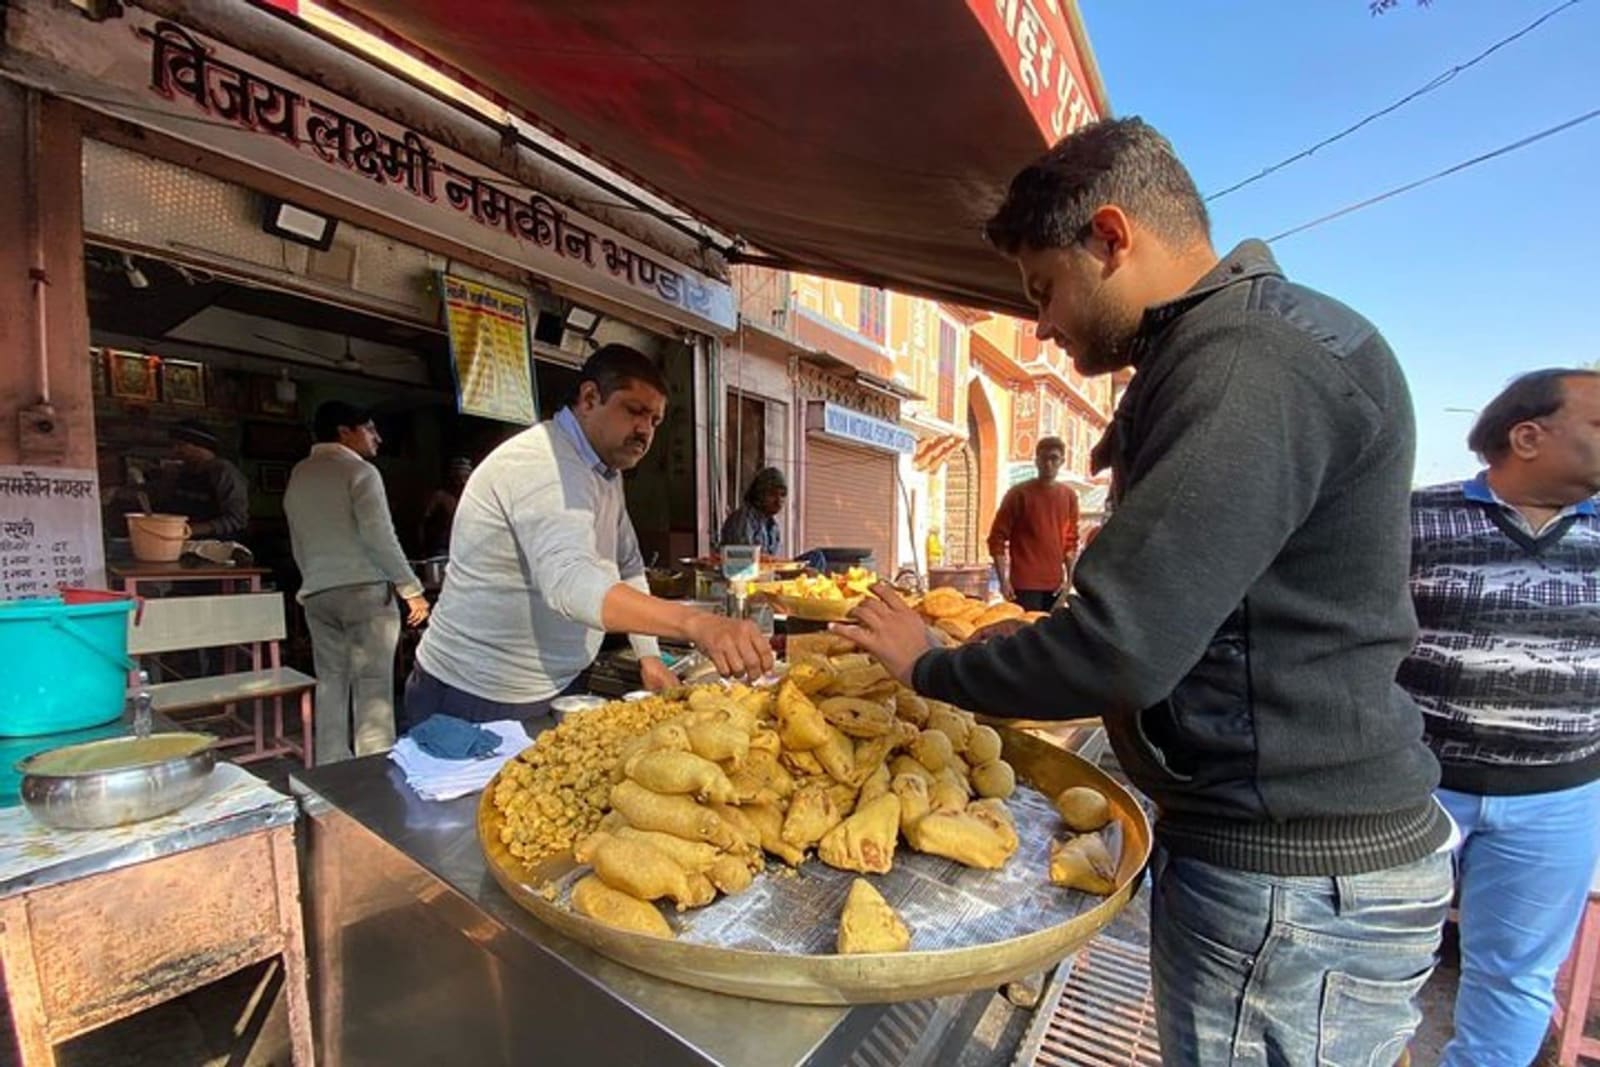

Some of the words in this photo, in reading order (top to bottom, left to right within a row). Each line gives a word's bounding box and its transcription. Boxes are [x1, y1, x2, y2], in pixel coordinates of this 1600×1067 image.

[139, 20, 305, 148] विजय
[306, 100, 442, 202] लक्ष्मी
[441, 162, 597, 267] नमकीन
[602, 238, 713, 316] भण्डार
